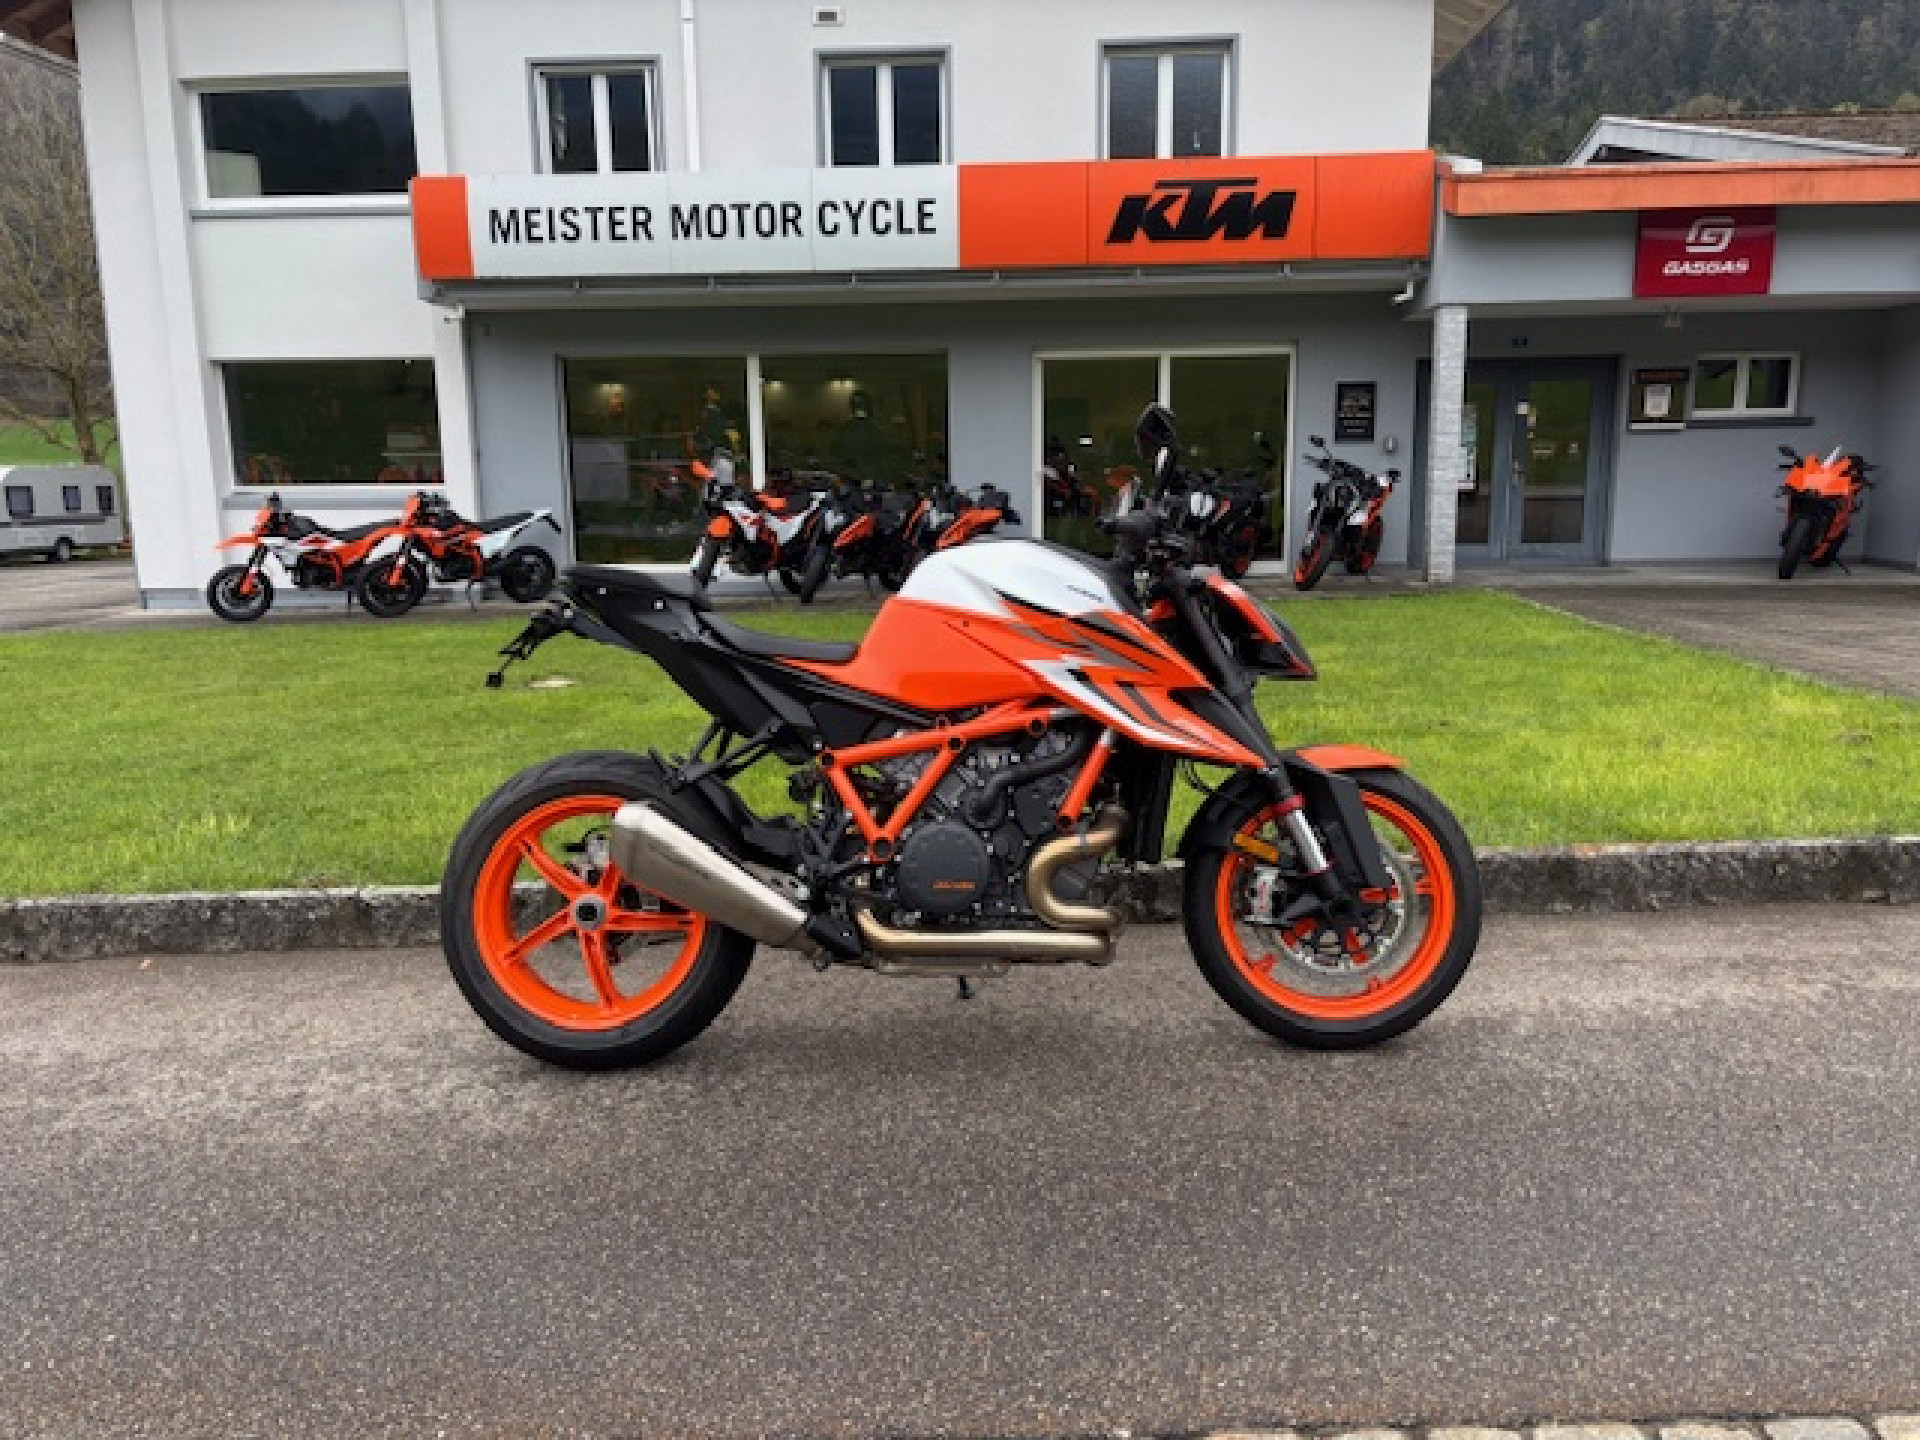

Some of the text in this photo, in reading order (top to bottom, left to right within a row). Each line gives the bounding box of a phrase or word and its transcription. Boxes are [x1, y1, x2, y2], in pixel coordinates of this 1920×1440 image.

[489, 198, 937, 244] MEISTER MOTOR CYCLE
[1105, 177, 1297, 244] KTM
